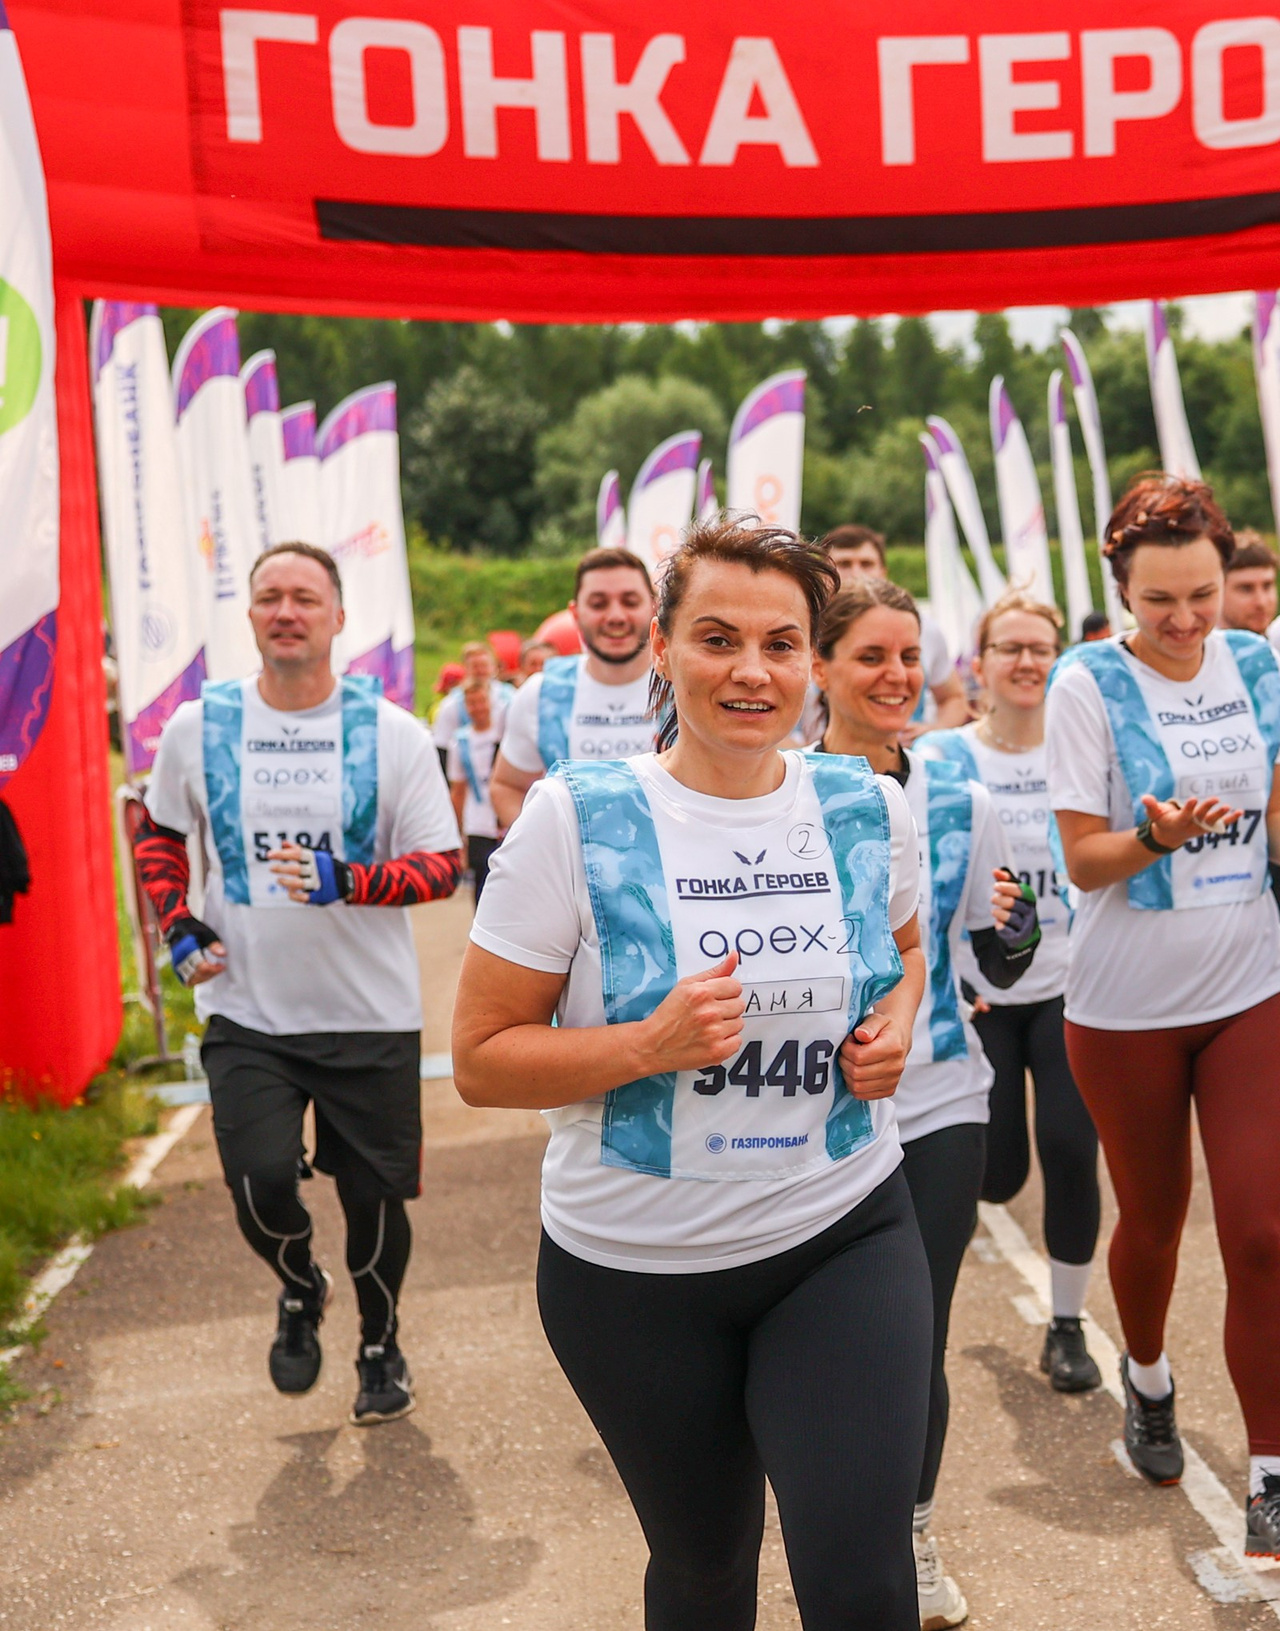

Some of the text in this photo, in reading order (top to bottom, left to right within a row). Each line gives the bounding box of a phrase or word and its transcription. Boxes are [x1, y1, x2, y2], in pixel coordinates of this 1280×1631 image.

[220, 9, 820, 167] ГОНКА
[1158, 699, 1248, 723] ГОНКА ГЕРОЕВ
[1181, 734, 1256, 761] apex
[676, 871, 829, 895] ГОНКА ГЕРОЕВ
[693, 1039, 835, 1098] 5446
[731, 1132, 809, 1150] ГАЗПРОМБАНК
